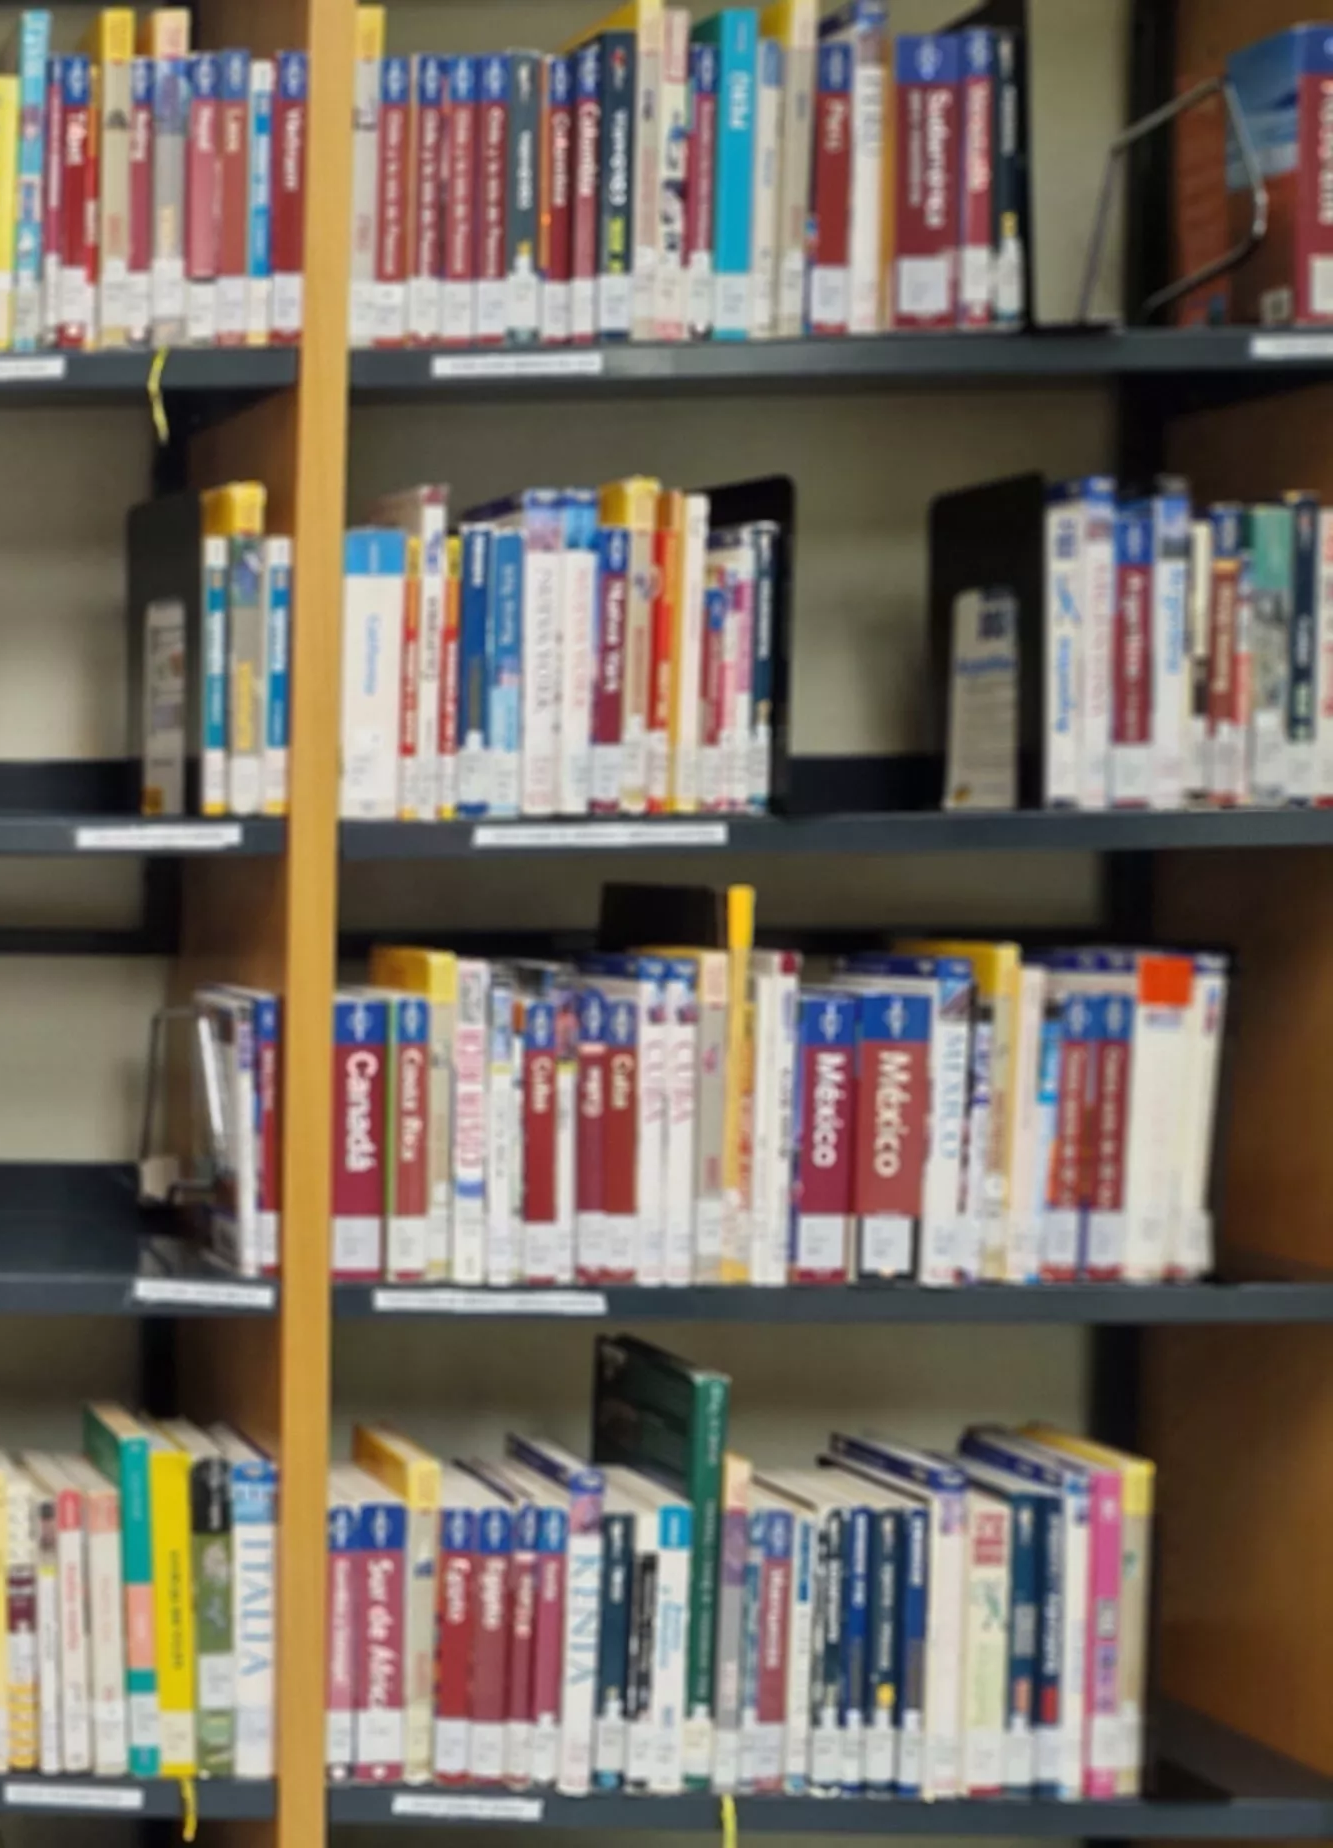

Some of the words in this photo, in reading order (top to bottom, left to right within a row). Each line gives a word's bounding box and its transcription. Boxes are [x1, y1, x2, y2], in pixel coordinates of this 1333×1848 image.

[925, 88, 952, 230] Sudamérica
[345, 1051, 380, 1172] Canadá
[400, 1048, 425, 1110] Costa
[533, 1055, 554, 1114] Cuba
[612, 1053, 634, 1110] Cuba
[813, 1051, 845, 1168] México
[876, 1050, 912, 1178] México
[400, 1115, 425, 1162] Rica
[240, 1539, 272, 1677] ITALIA
[367, 1558, 395, 1601] Sur
[367, 1604, 394, 1641] de
[570, 1554, 601, 1687] KENIA
